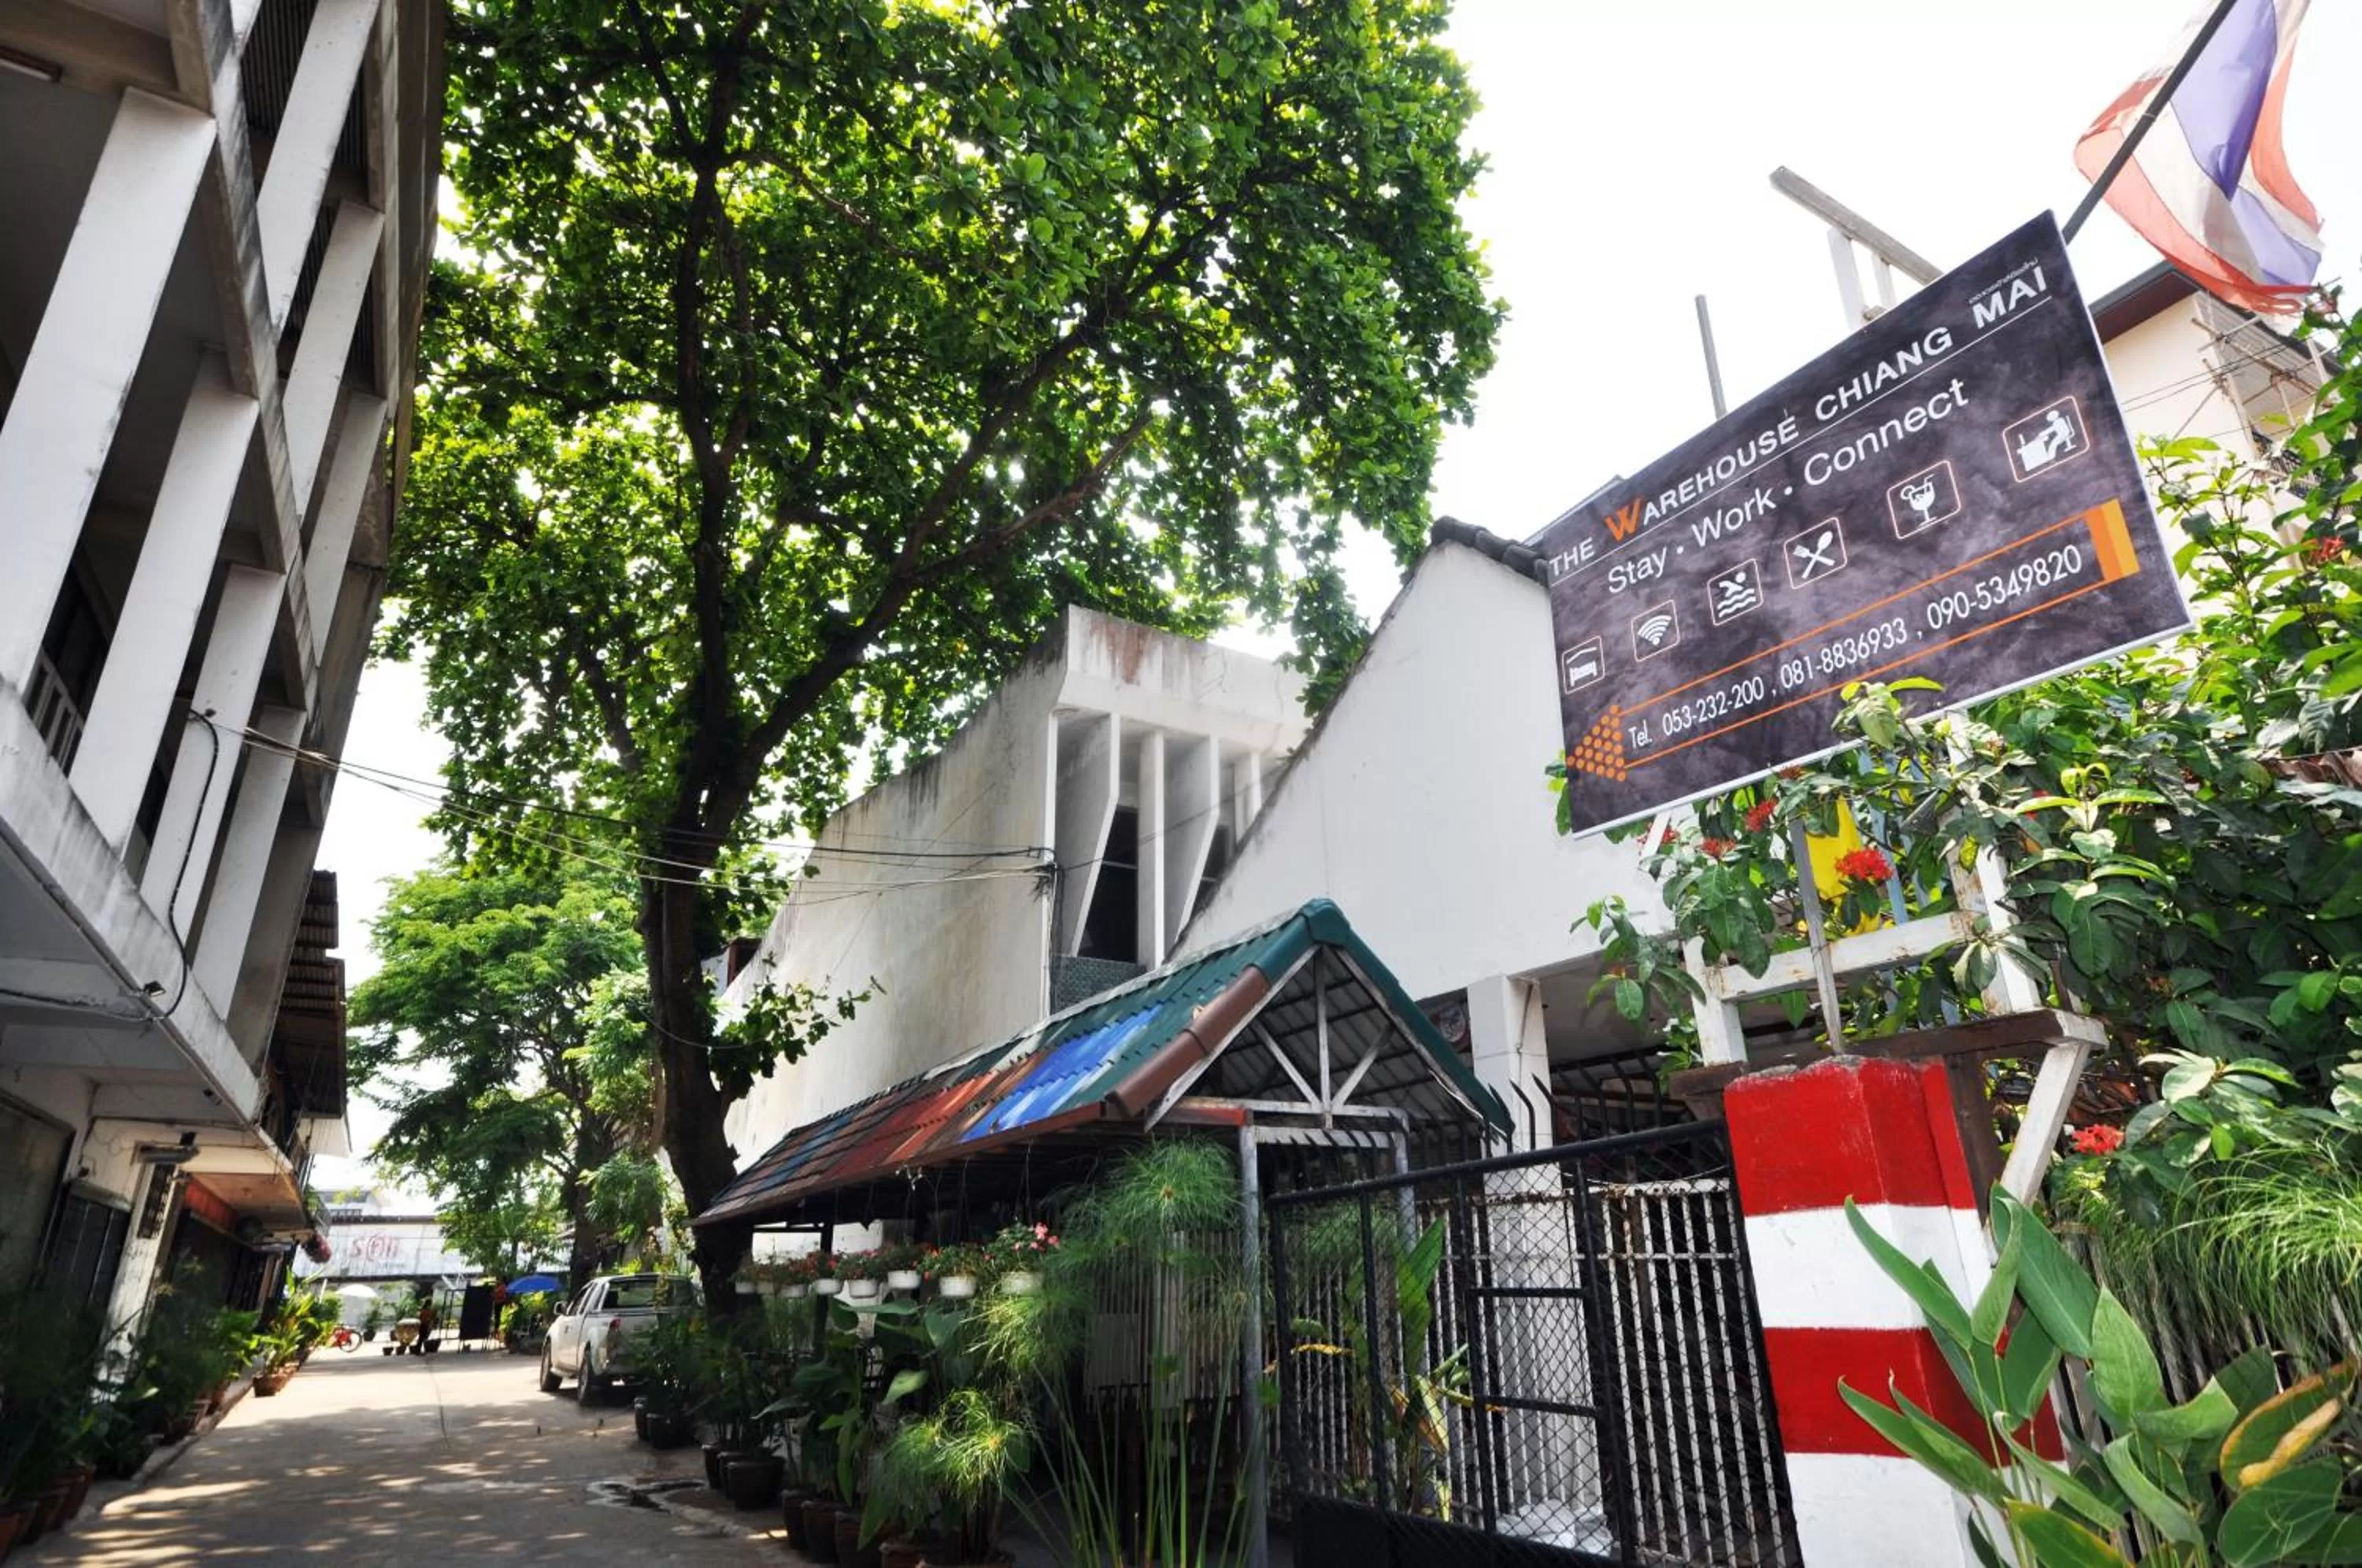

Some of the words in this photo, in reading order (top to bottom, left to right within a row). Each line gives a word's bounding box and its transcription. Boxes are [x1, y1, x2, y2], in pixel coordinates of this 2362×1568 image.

[1549, 537, 1595, 576] THE
[1604, 415, 1799, 542] WAREHOUSE
[1815, 326, 1953, 422] CHIANG
[1972, 265, 2047, 329] MAI
[1608, 546, 1668, 594] Stay
[1691, 487, 1777, 548] Work
[1804, 378, 1970, 486] Connect
[1628, 719, 1653, 749] Tel.
[1927, 544, 2082, 630] 090-5349820
